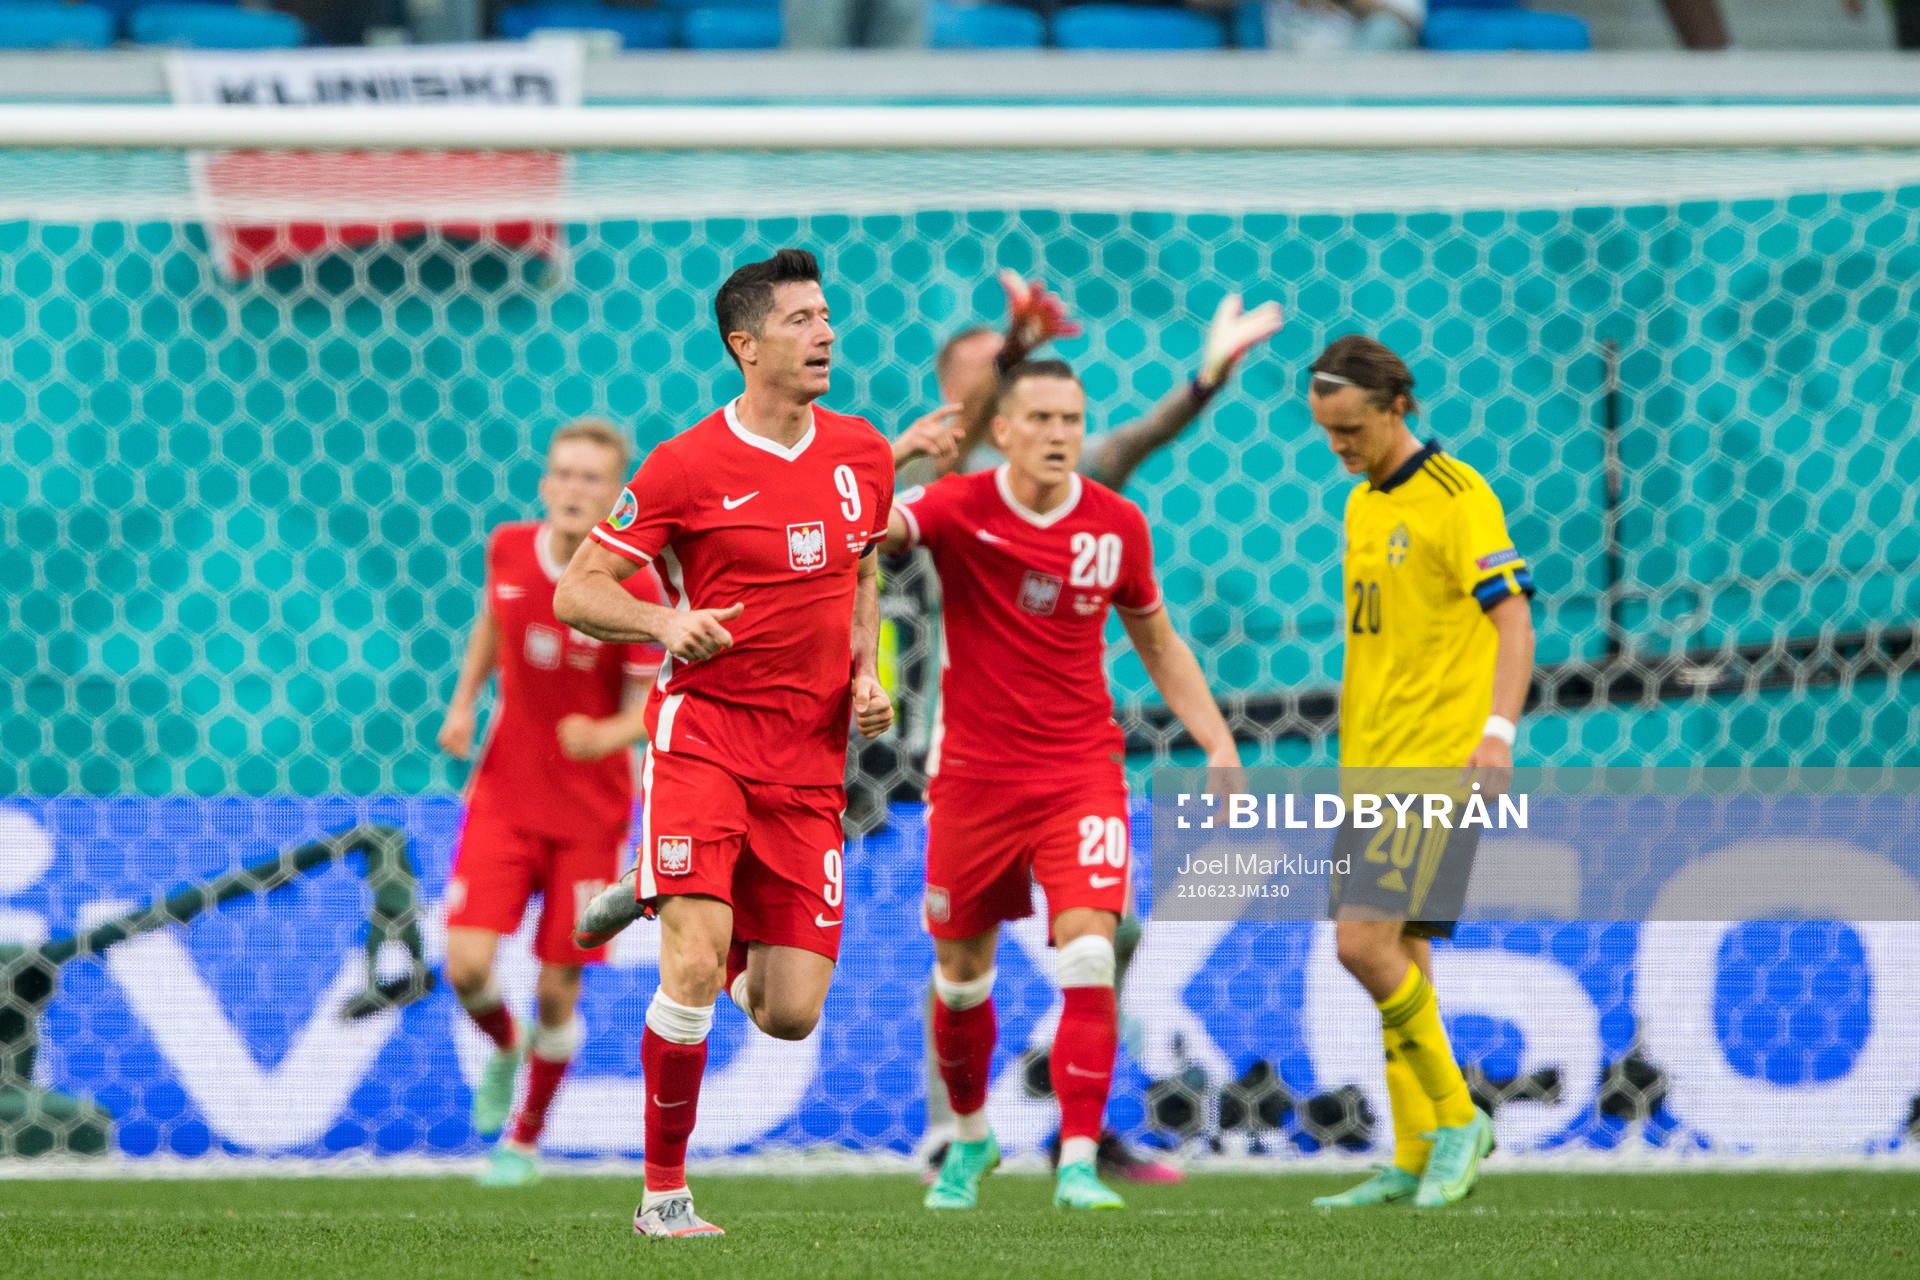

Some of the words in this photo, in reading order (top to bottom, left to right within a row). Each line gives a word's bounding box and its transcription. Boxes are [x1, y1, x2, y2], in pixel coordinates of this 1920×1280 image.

[833, 464, 862, 522] 9
[1070, 531, 1123, 588] 20
[1352, 580, 1381, 635] 20
[1079, 814, 1127, 868] 20
[823, 848, 843, 907] 9
